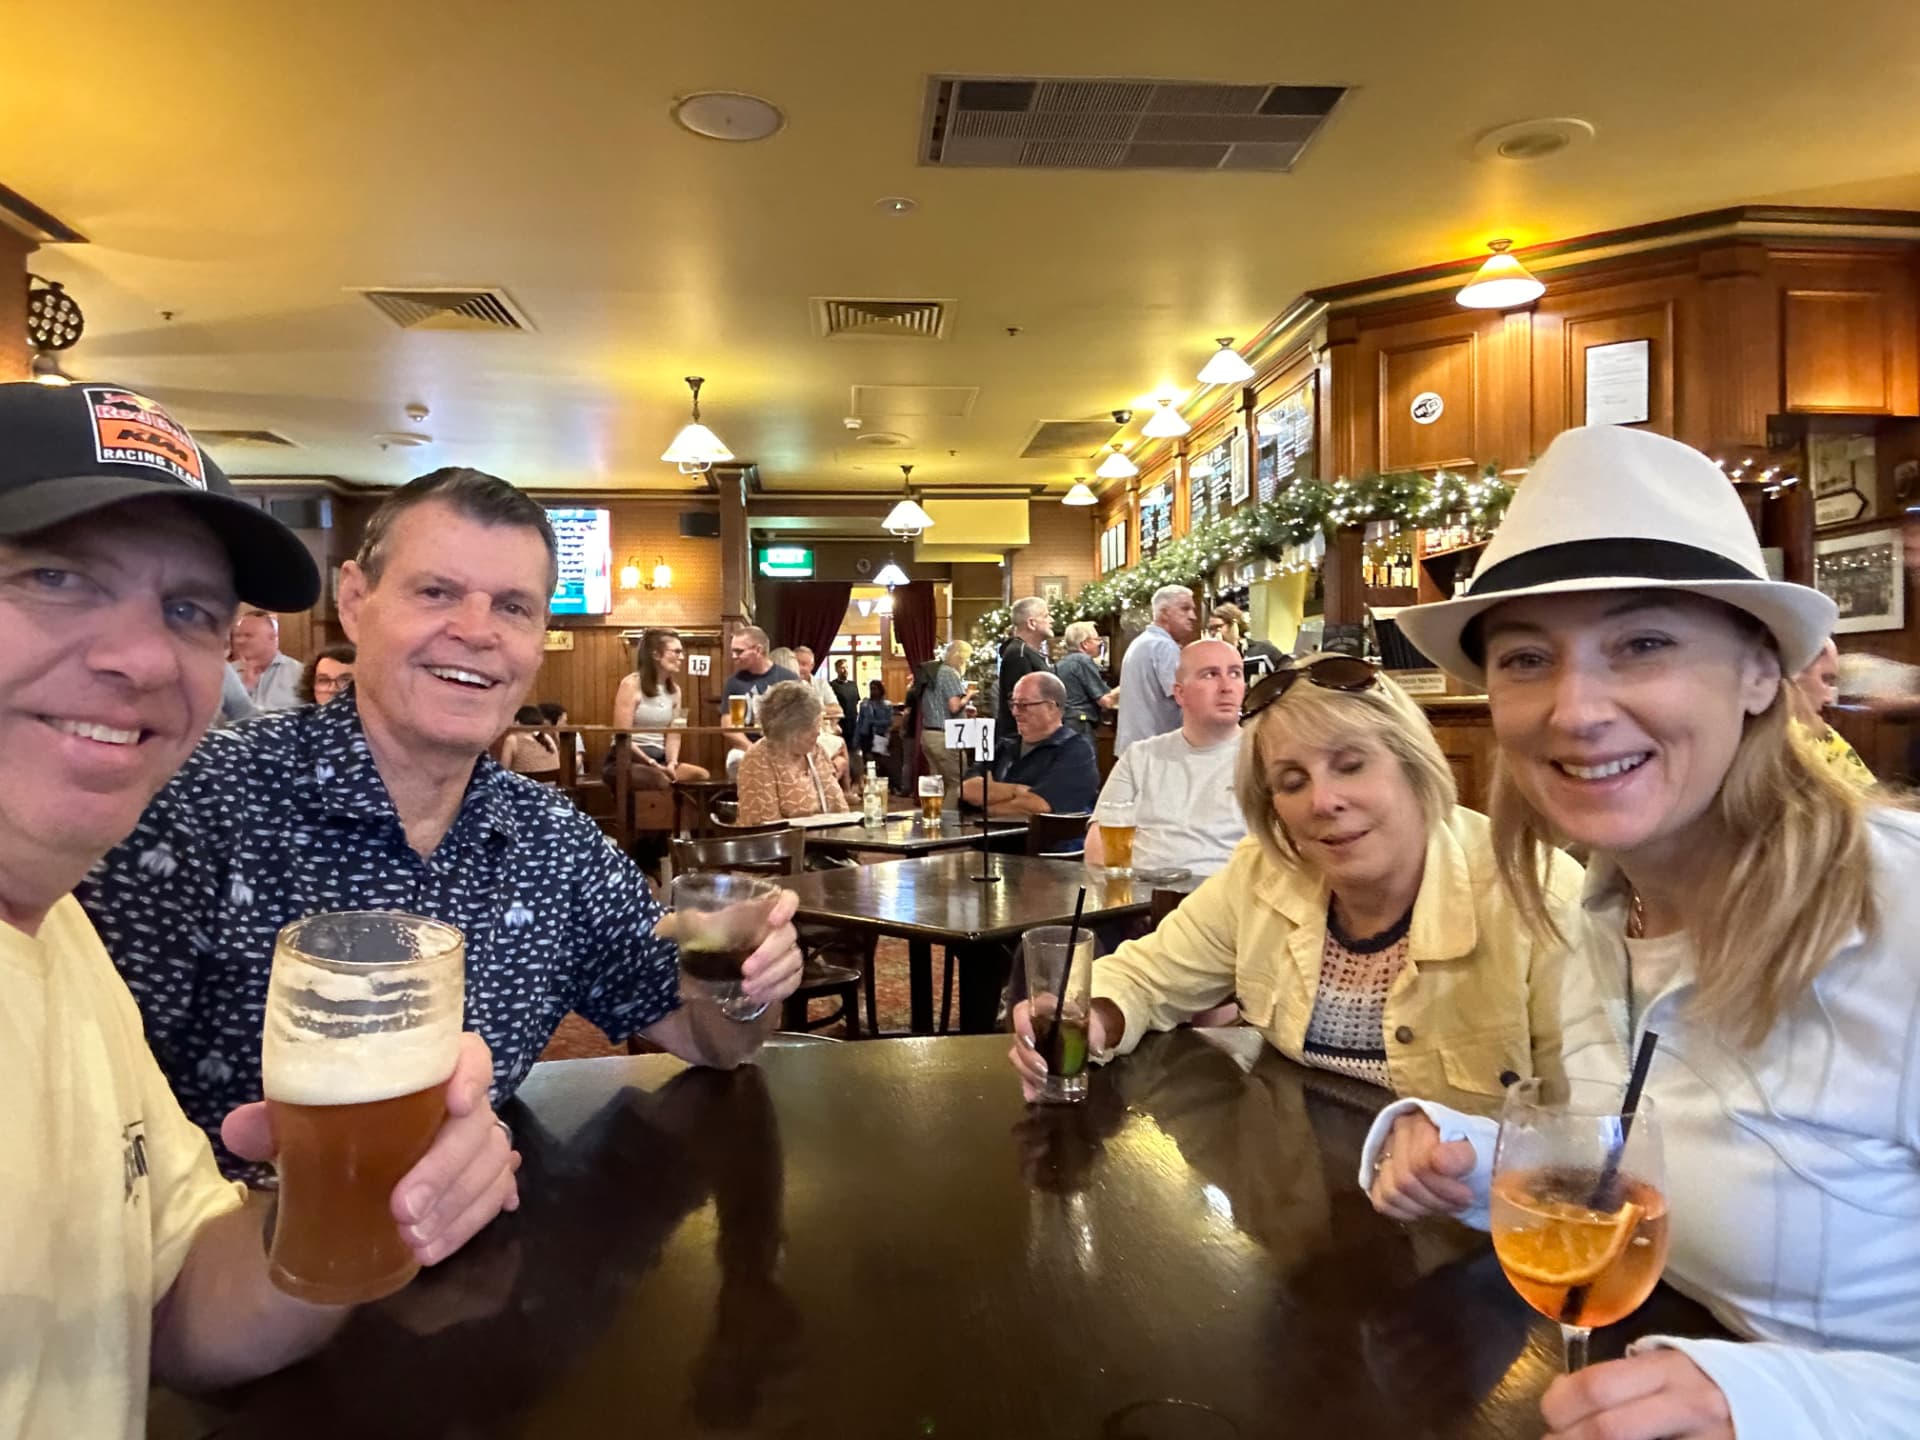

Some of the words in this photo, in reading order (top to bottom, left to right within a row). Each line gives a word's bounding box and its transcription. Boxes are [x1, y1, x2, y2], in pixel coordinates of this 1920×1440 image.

[95, 405, 152, 425] Red
[117, 429, 189, 462] KTM
[103, 448, 166, 466] RACING
[170, 462, 202, 488] TEAM
[692, 659, 708, 672] 15
[954, 723, 966, 743] 7
